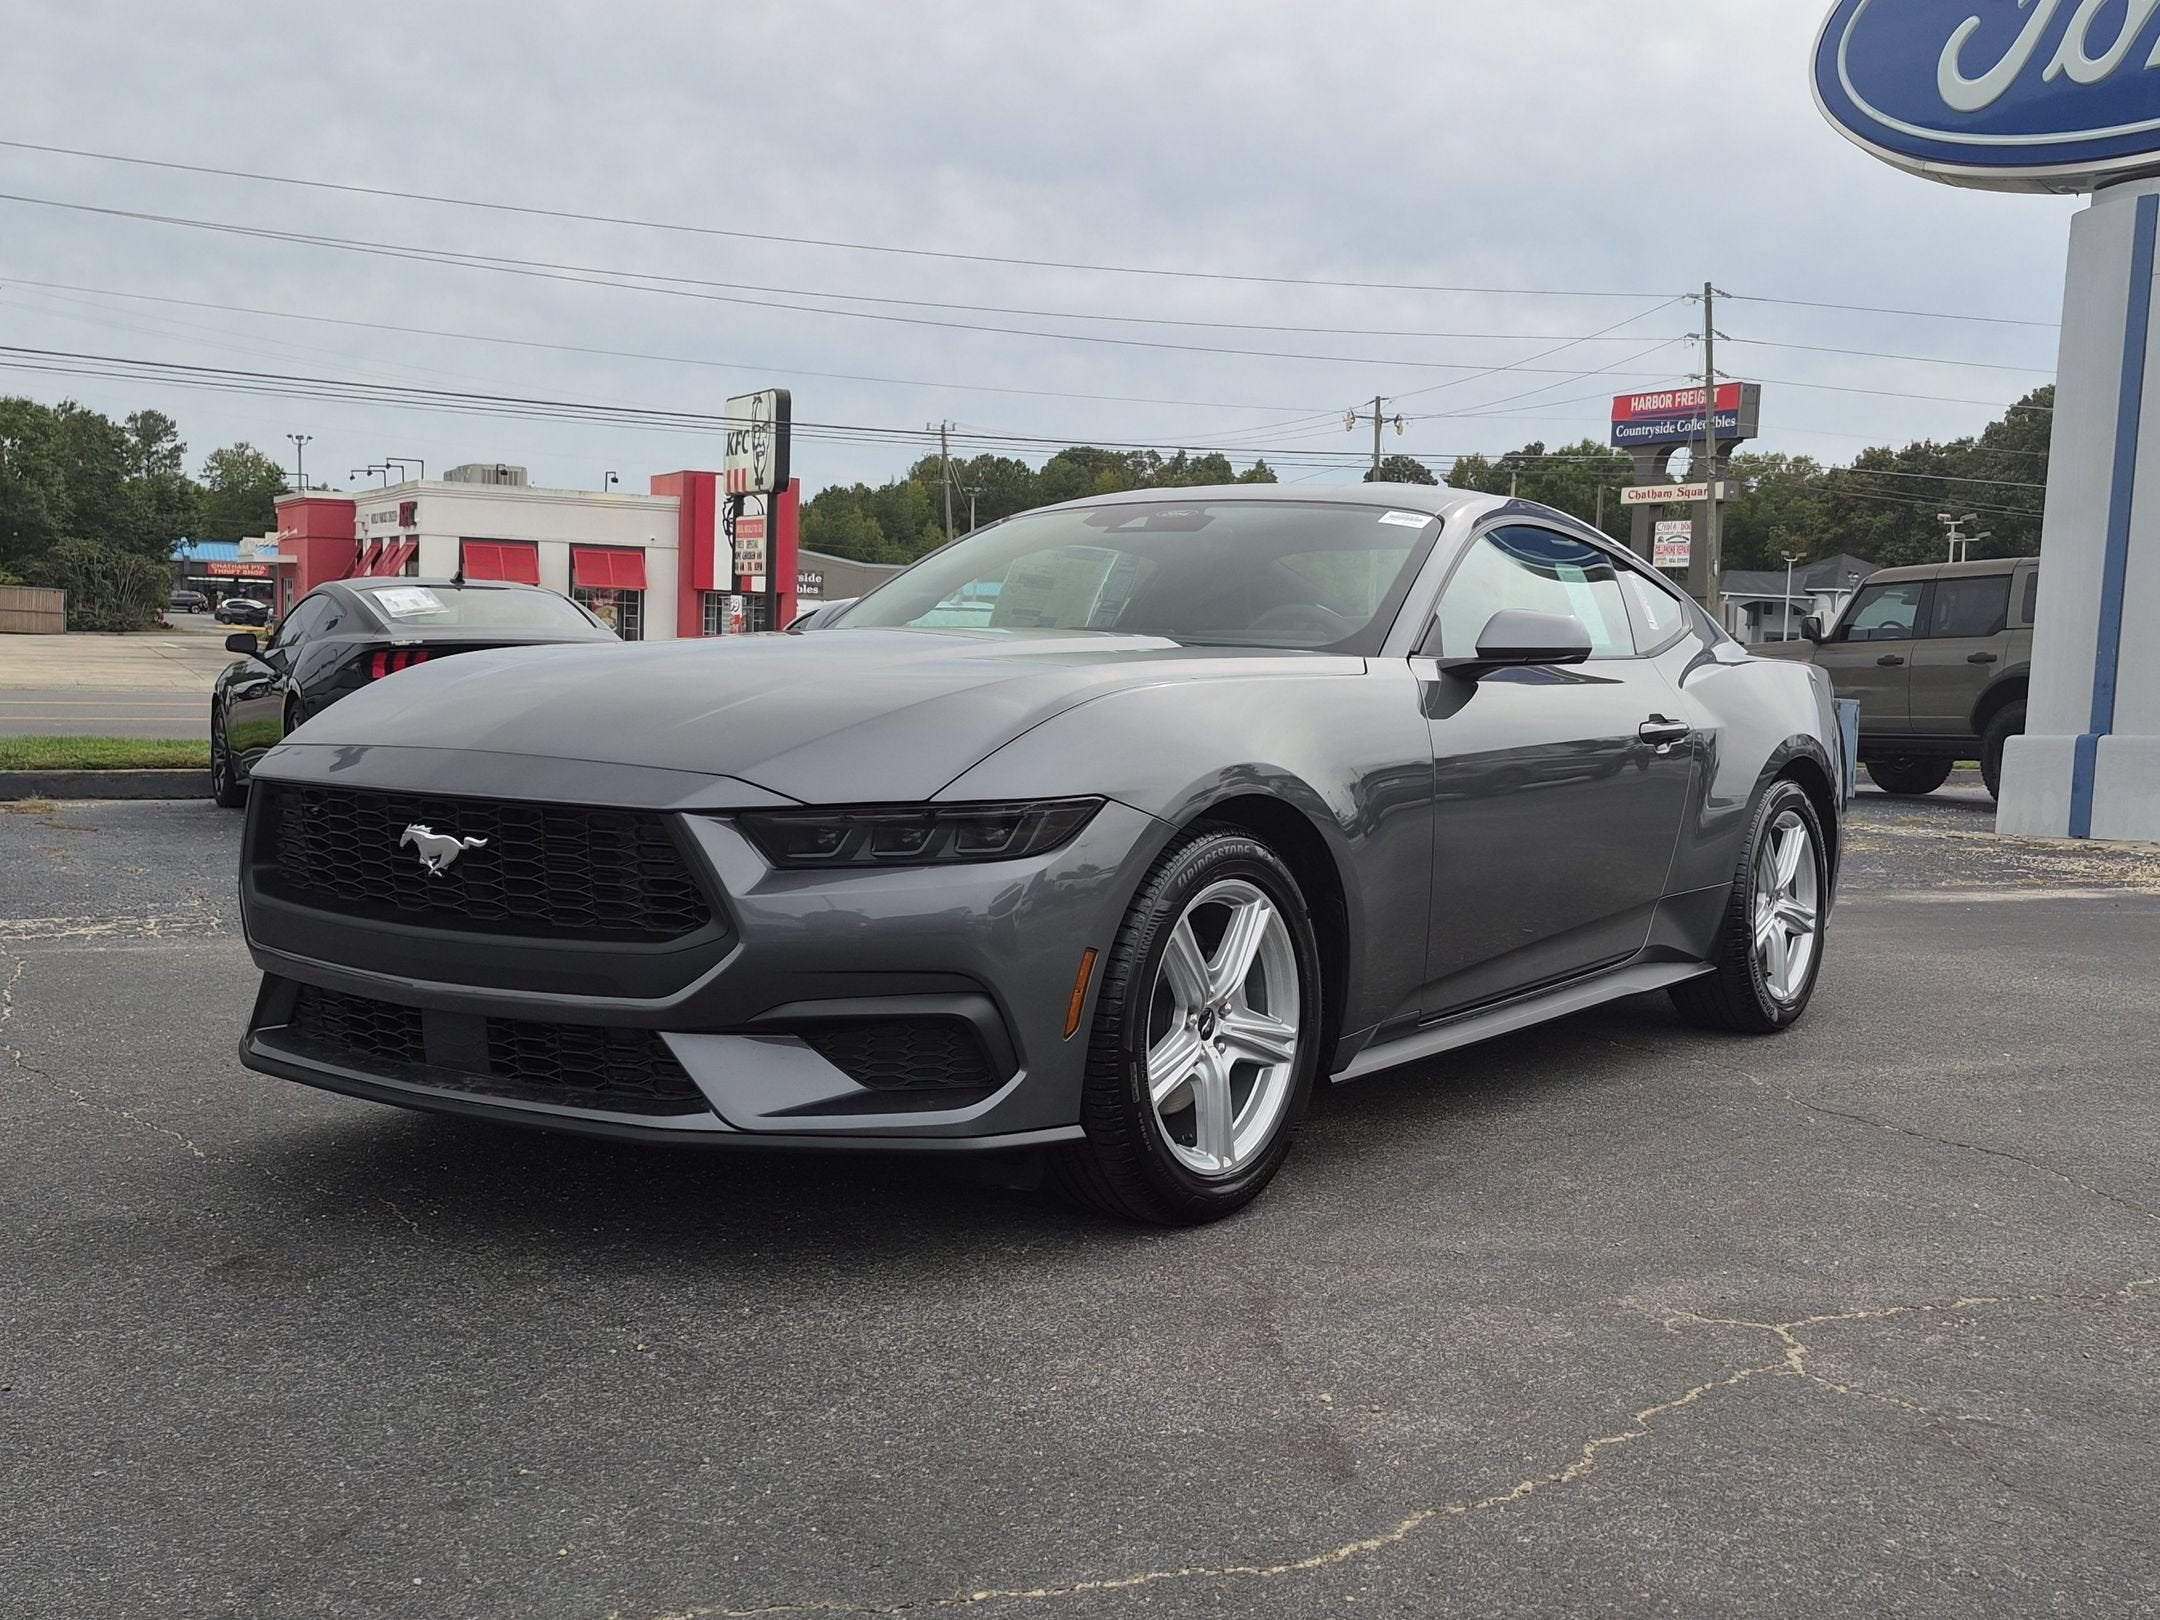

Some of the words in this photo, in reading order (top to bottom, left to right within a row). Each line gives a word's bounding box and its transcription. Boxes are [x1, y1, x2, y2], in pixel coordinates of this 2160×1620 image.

[1631, 395, 1673, 412] HARBOR
[1674, 387, 1720, 408] FREIGT
[1615, 420, 1675, 439] Countryside
[1677, 414, 1736, 433] Collecbles
[726, 429, 750, 457] KFC
[1627, 489, 1673, 500] Chatham
[1676, 486, 1709, 499] Squar
[210, 562, 249, 570] CHATHAM
